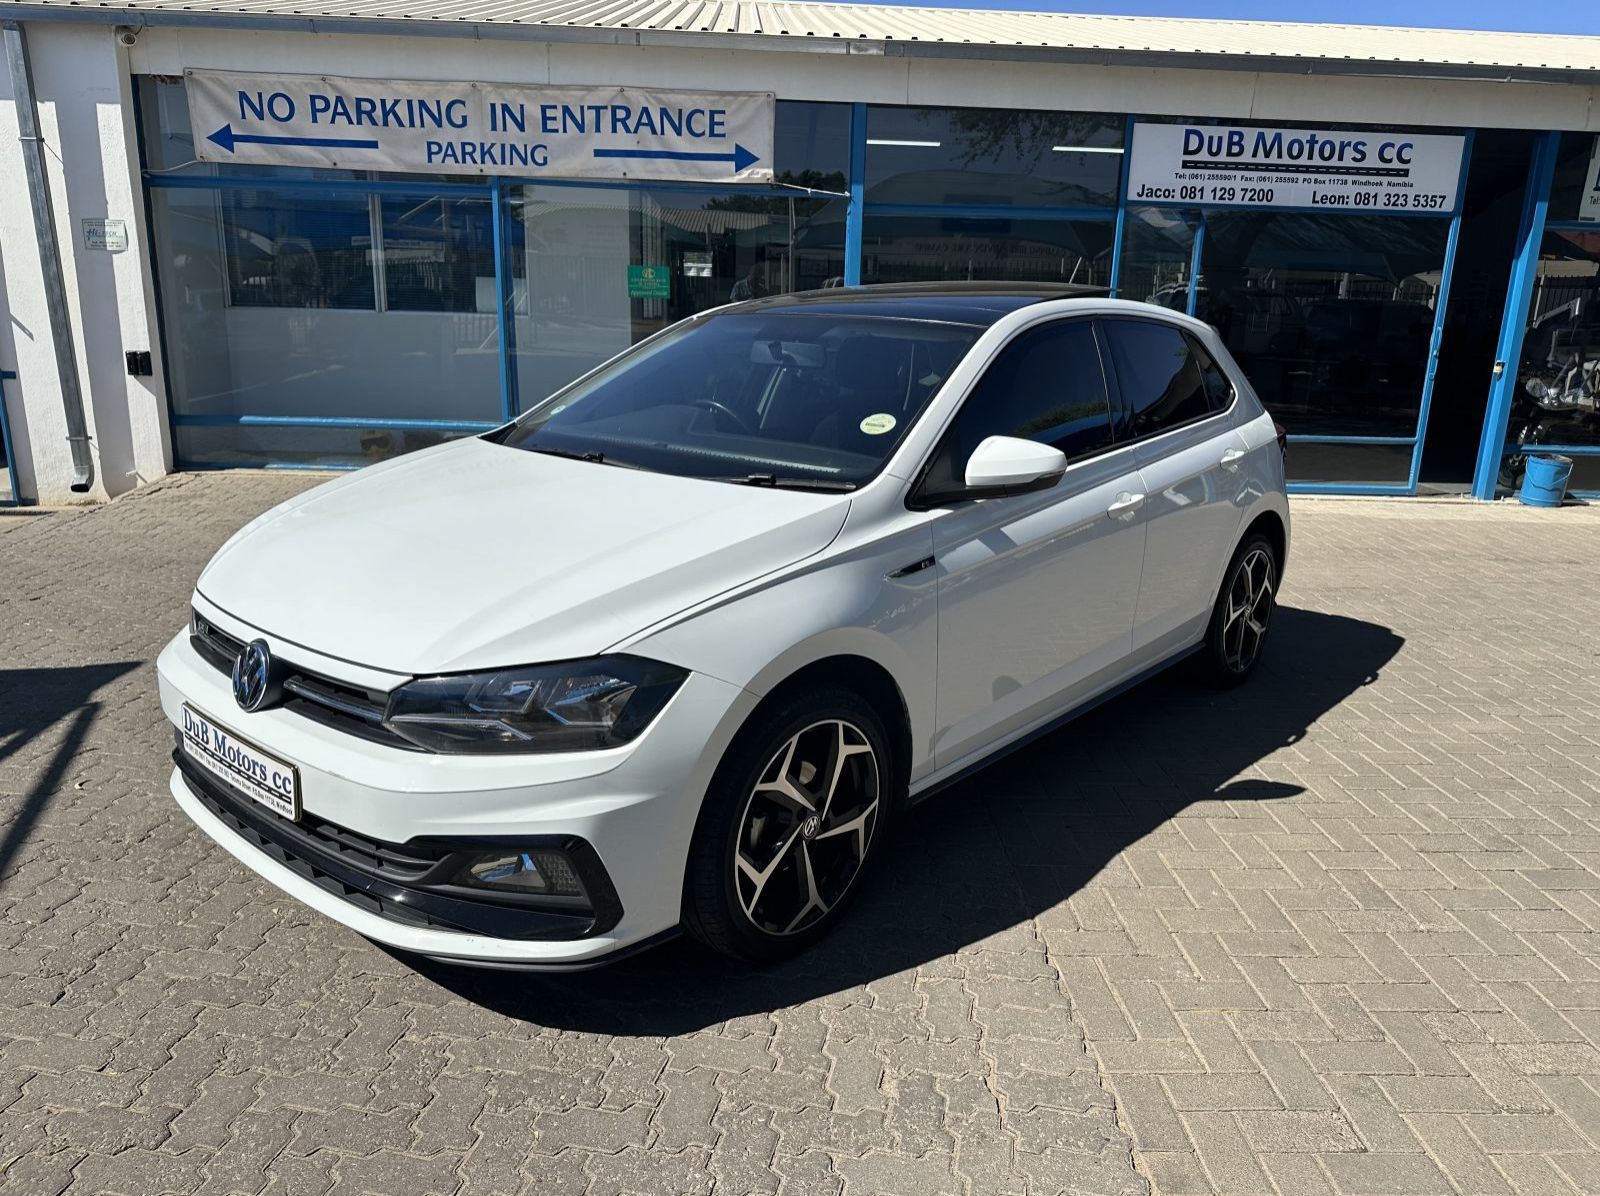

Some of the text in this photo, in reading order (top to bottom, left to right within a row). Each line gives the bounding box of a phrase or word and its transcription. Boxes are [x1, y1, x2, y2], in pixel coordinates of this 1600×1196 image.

[238, 91, 727, 138] NO PARKING IN ENTRANCE
[426, 140, 548, 167] PARKING
[1182, 128, 1414, 164] DuB Motors cc
[1174, 172, 1187, 180] Tel:
[1188, 173, 1206, 181] (061)
[1207, 173, 1237, 182] 255590/1
[1240, 175, 1255, 183] Fax:
[1256, 175, 1273, 184] (061)
[1274, 176, 1299, 184] 255592
[1351, 179, 1384, 187] Windhoek
[1136, 184, 1274, 203] Jaco: 081 129 7200
[1311, 190, 1447, 209] Leon: 081 323 5357
[183, 706, 209, 745] DuB
[213, 728, 267, 782] Motors
[273, 771, 292, 795] cc
